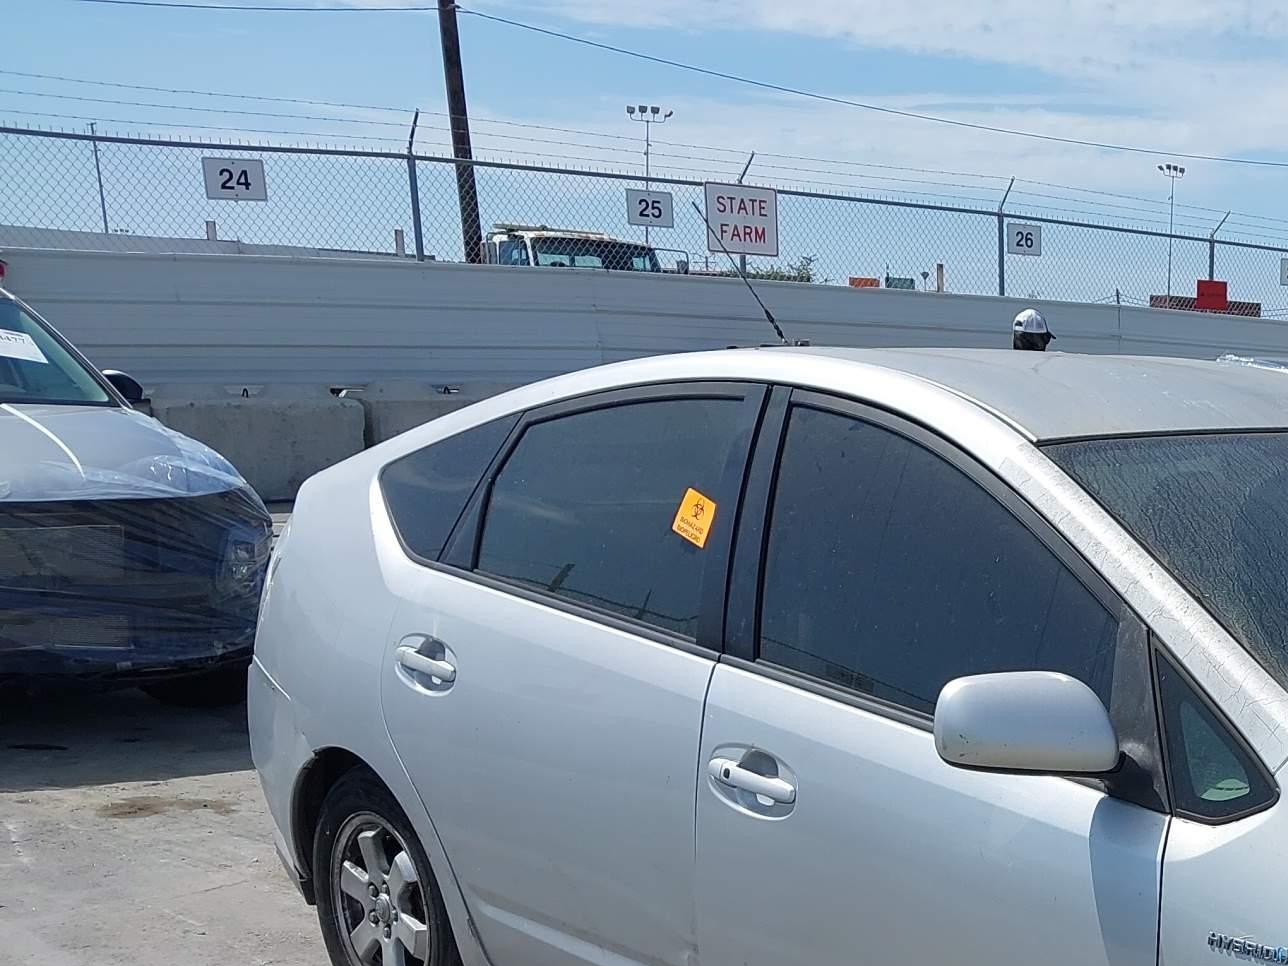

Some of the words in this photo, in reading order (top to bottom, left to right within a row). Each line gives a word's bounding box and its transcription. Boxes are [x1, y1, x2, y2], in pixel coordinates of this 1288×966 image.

[219, 168, 252, 191] 24
[638, 199, 662, 219] 25
[716, 195, 768, 218] STATE
[720, 223, 766, 244] FARM
[1016, 231, 1034, 248] 26
[1207, 931, 1275, 962] HYBRID
